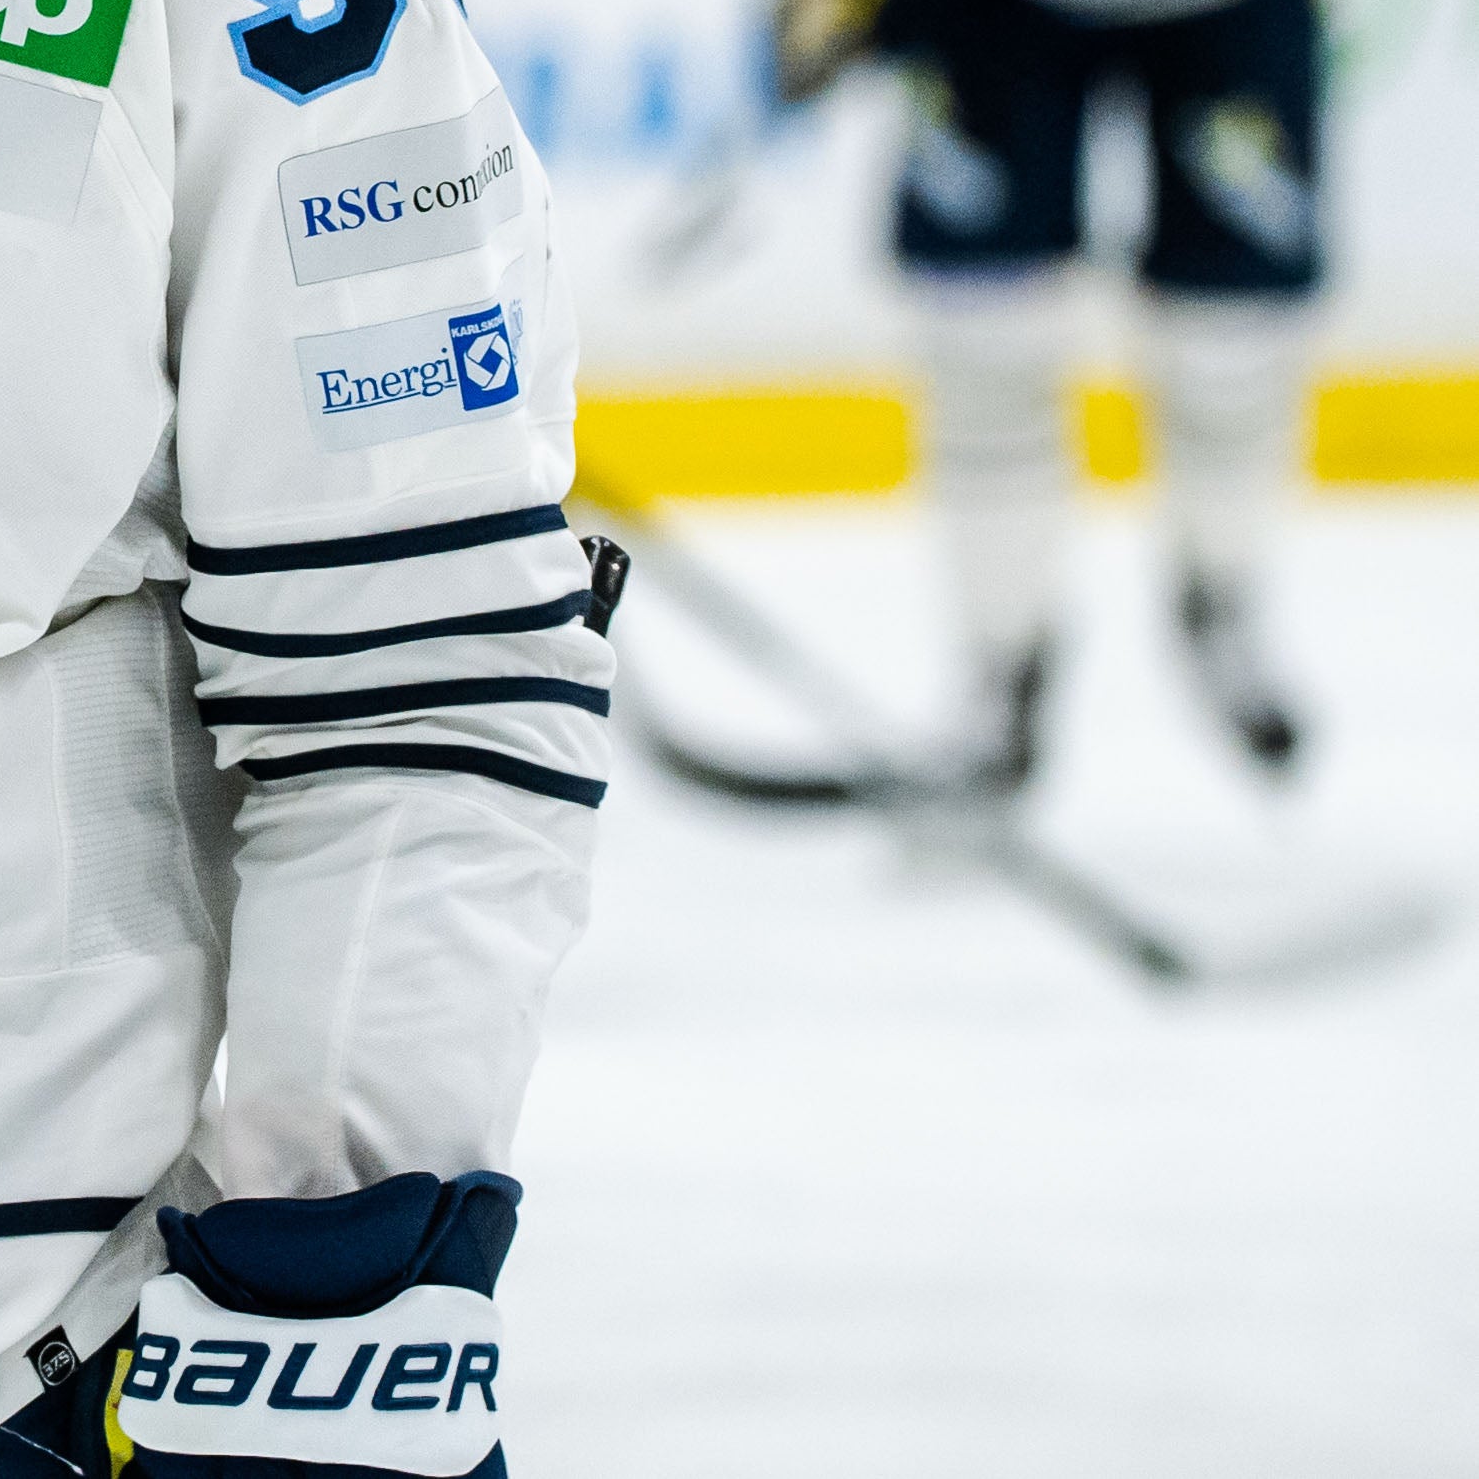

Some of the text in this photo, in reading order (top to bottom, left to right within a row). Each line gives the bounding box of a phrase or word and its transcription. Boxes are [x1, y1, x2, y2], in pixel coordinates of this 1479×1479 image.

[299, 180, 405, 238] RSG
[316, 347, 458, 414] Energi
[121, 1332, 500, 1413] BAUER
